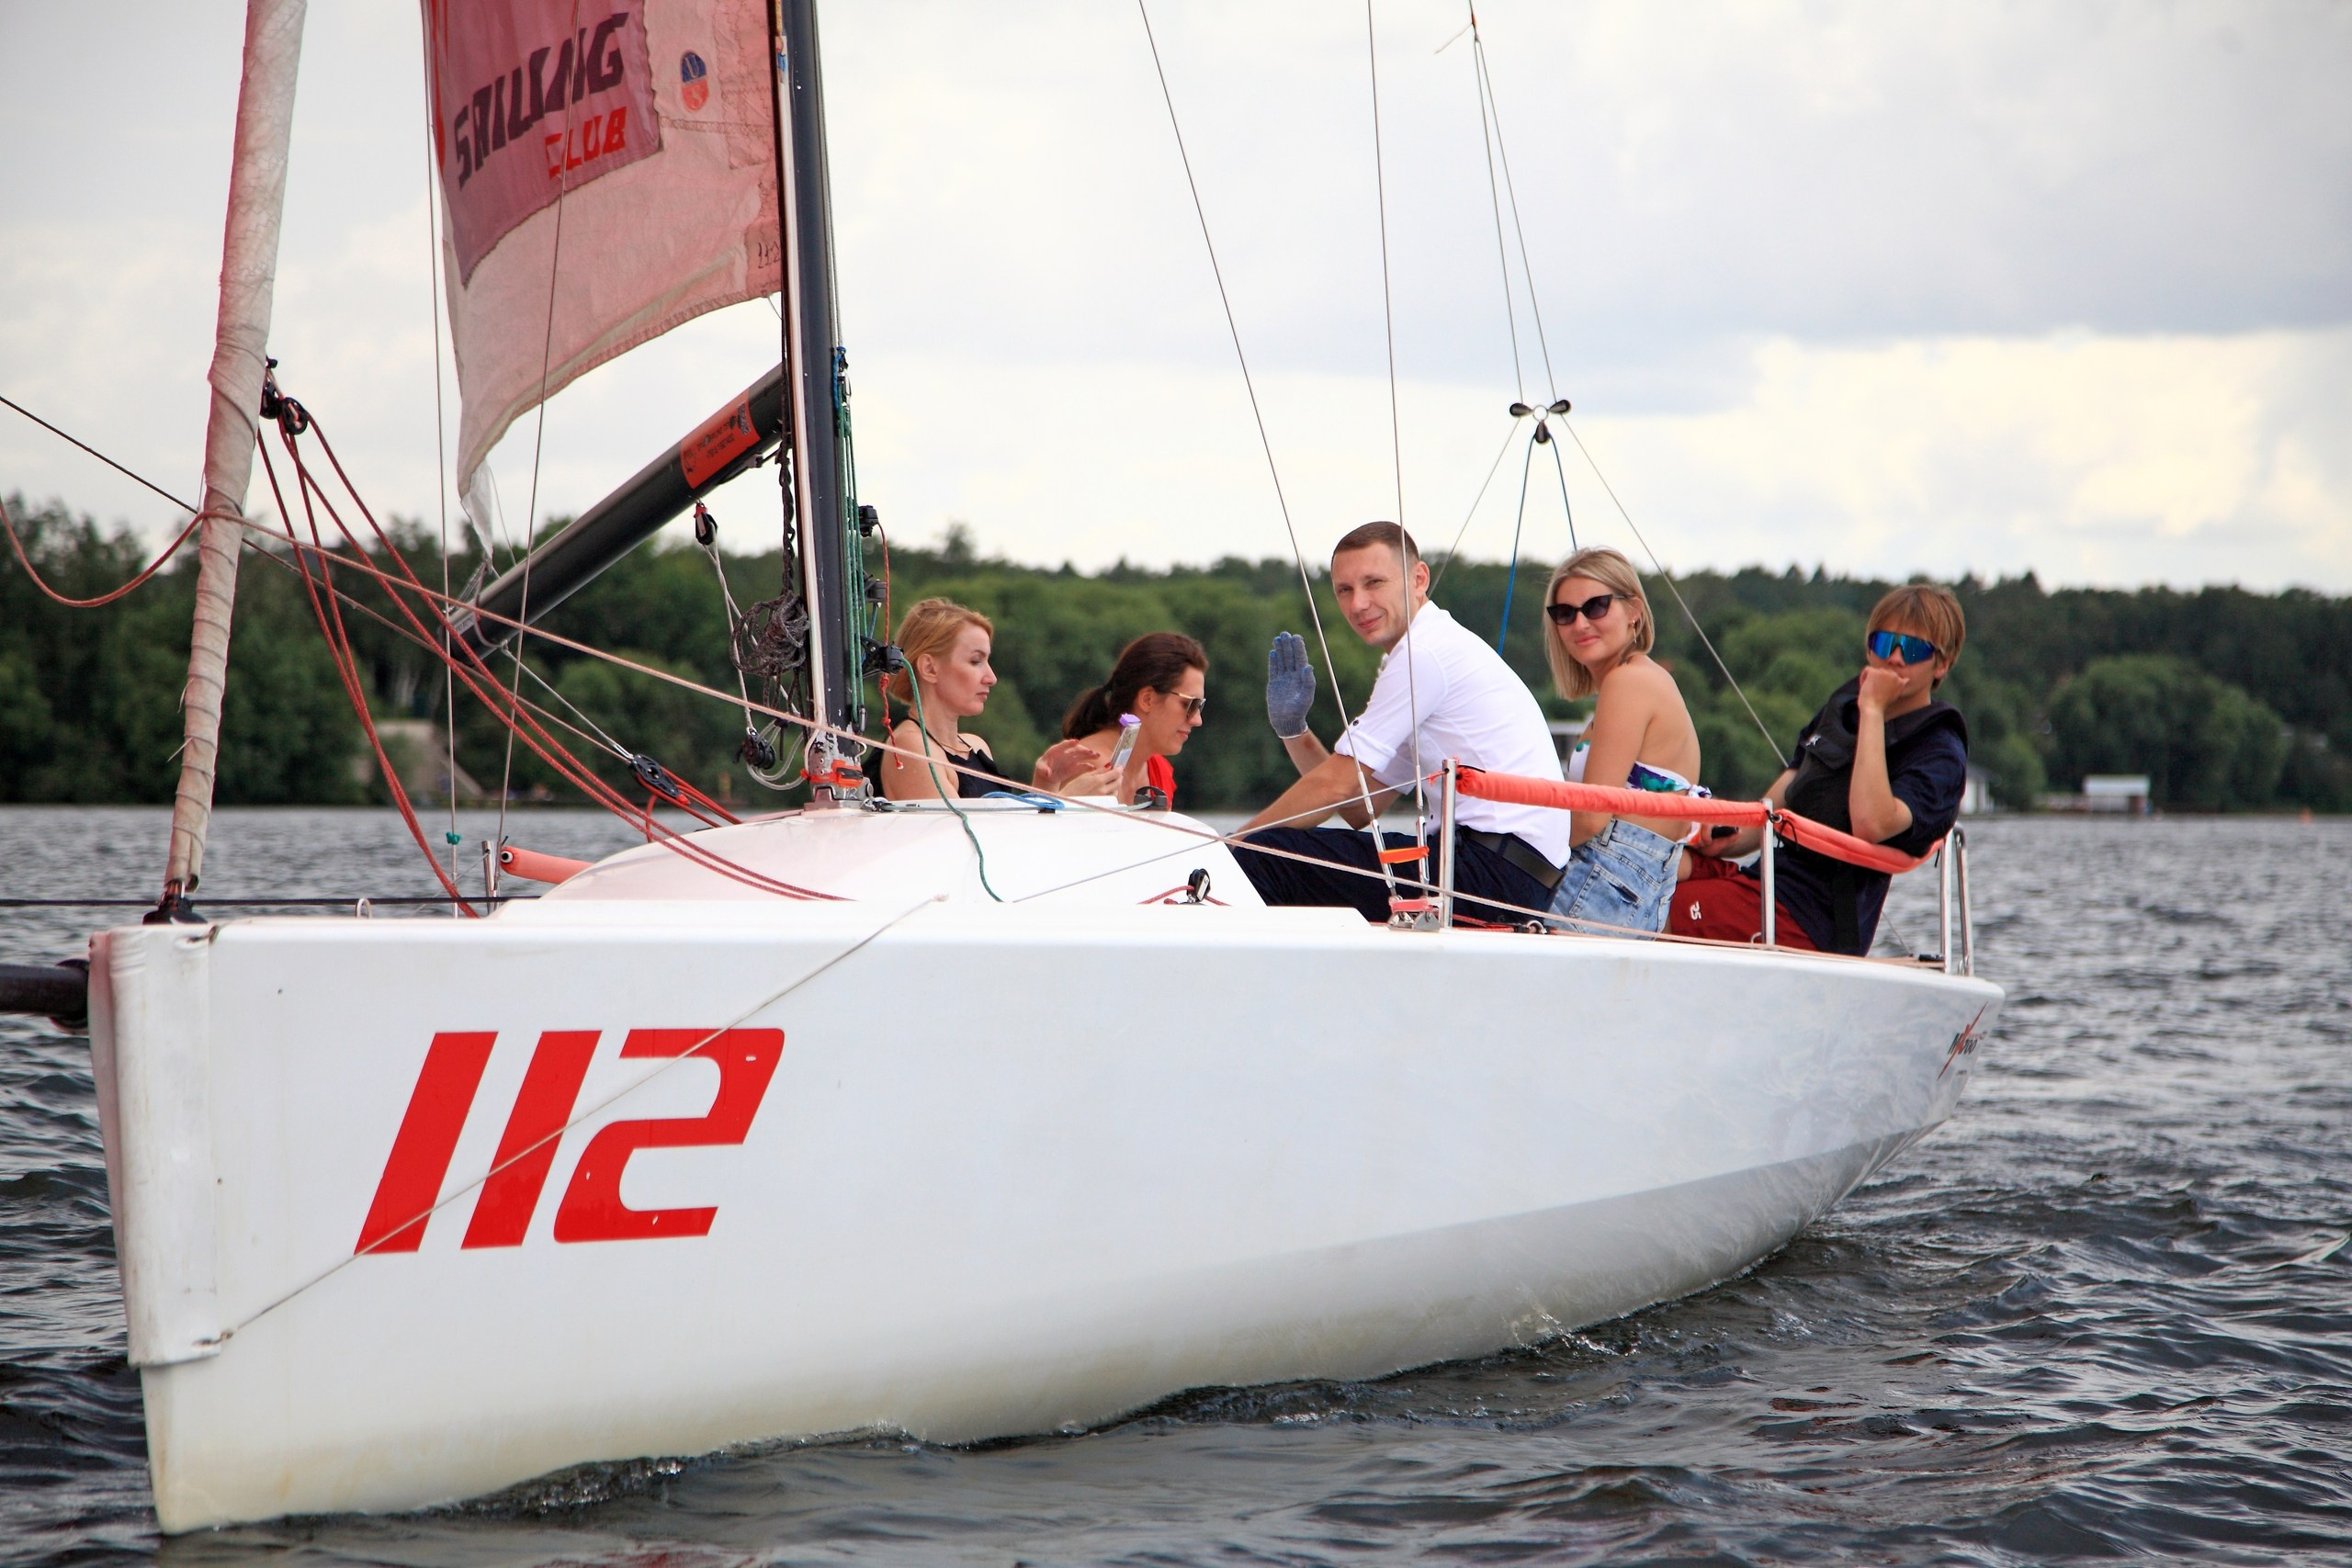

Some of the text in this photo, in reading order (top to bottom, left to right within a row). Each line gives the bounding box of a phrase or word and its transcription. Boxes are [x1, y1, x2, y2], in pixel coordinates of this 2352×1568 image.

[454, 12, 629, 191] SAILING
[545, 106, 628, 180] CLUB
[354, 1028, 785, 1256] 112
